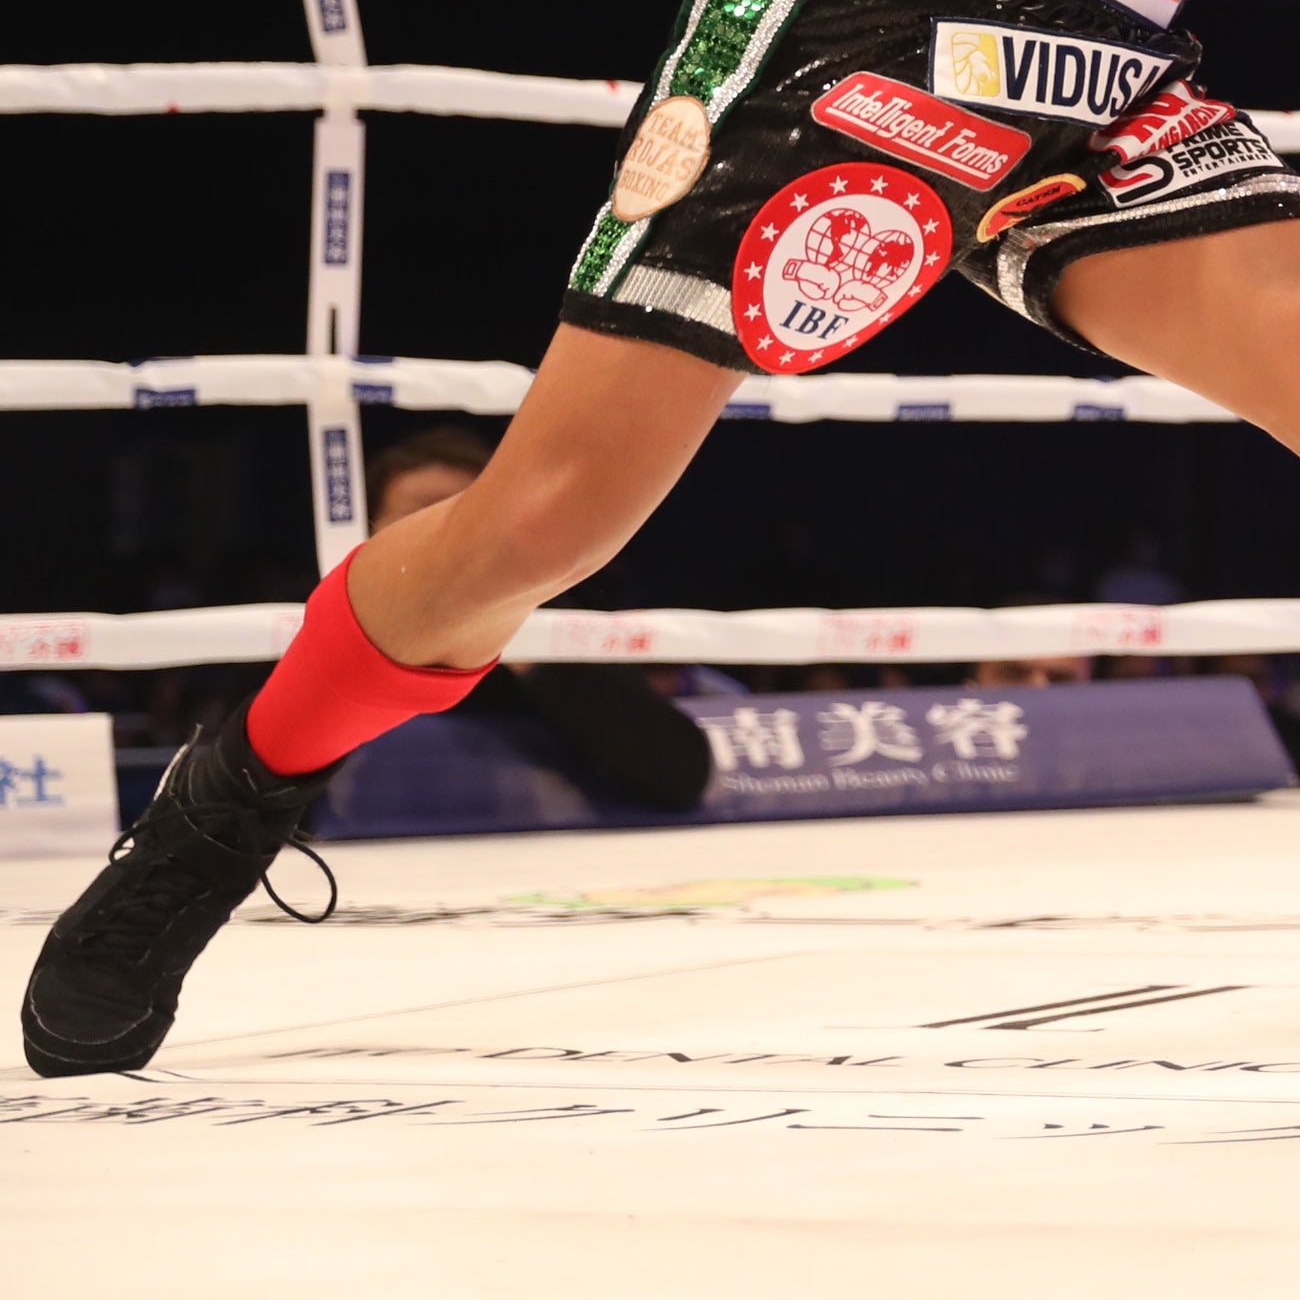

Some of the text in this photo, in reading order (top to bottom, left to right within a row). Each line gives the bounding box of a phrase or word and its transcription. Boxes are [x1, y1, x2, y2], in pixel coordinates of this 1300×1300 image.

[648, 112, 704, 151] TEAM
[833, 83, 1009, 175] Intelligent Forms
[628, 136, 697, 181] ROJAS
[1173, 138, 1269, 171] SPORTS
[1182, 153, 1272, 178] ENTERTAINMENT
[618, 169, 672, 201] BOXING
[779, 300, 850, 341] IBF
[476, 1047, 902, 1067] DENTAL
